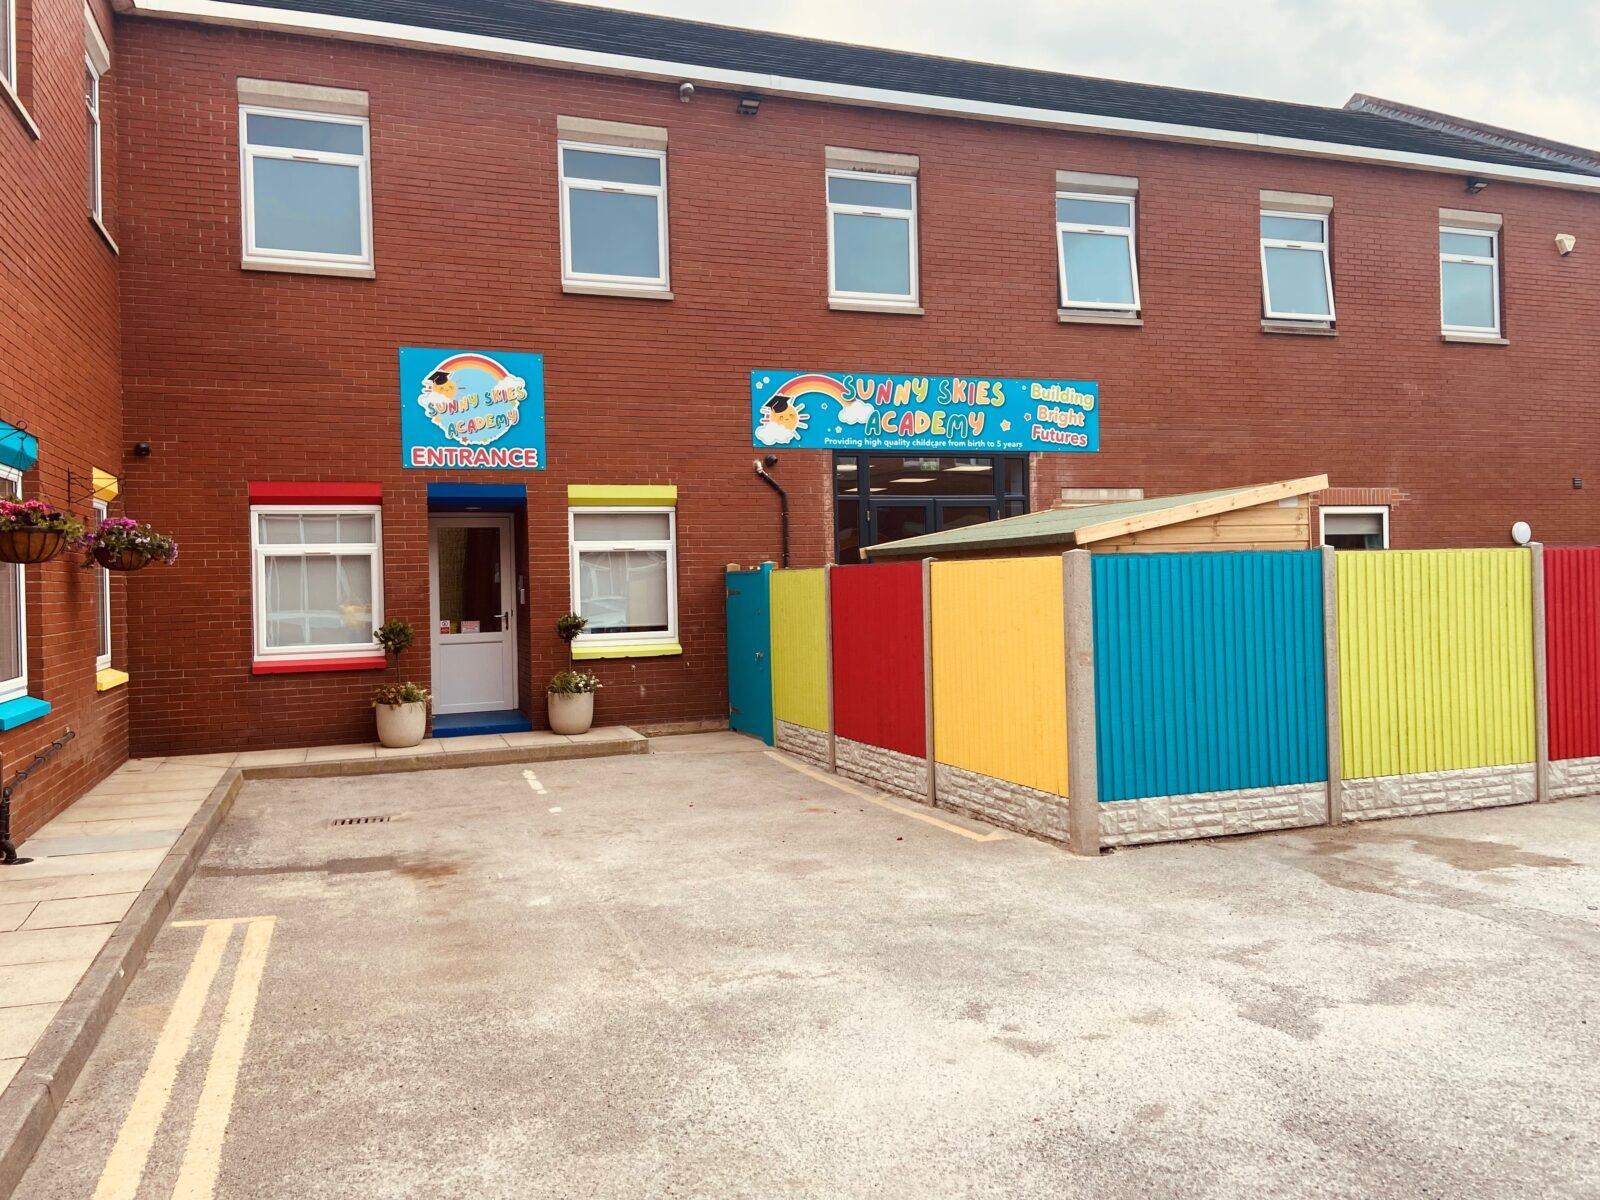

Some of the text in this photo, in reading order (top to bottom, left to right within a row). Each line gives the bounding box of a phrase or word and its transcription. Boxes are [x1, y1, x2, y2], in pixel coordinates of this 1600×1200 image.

[428, 386, 526, 416] SUNNY SKIES
[841, 375, 1005, 407] SUNNY SKIES
[1030, 382, 1094, 411] Building
[447, 410, 519, 437] ACADEMY
[865, 410, 985, 438] ACADEMY
[1037, 405, 1085, 427] Bright
[824, 437, 863, 447] Providing
[864, 438, 882, 448] high
[883, 438, 911, 448] quality
[912, 438, 946, 447] childcare
[948, 439, 966, 447] from
[1003, 441, 1023, 449] years
[1031, 424, 1088, 447] Futures
[411, 446, 538, 467] ENTRANCE
